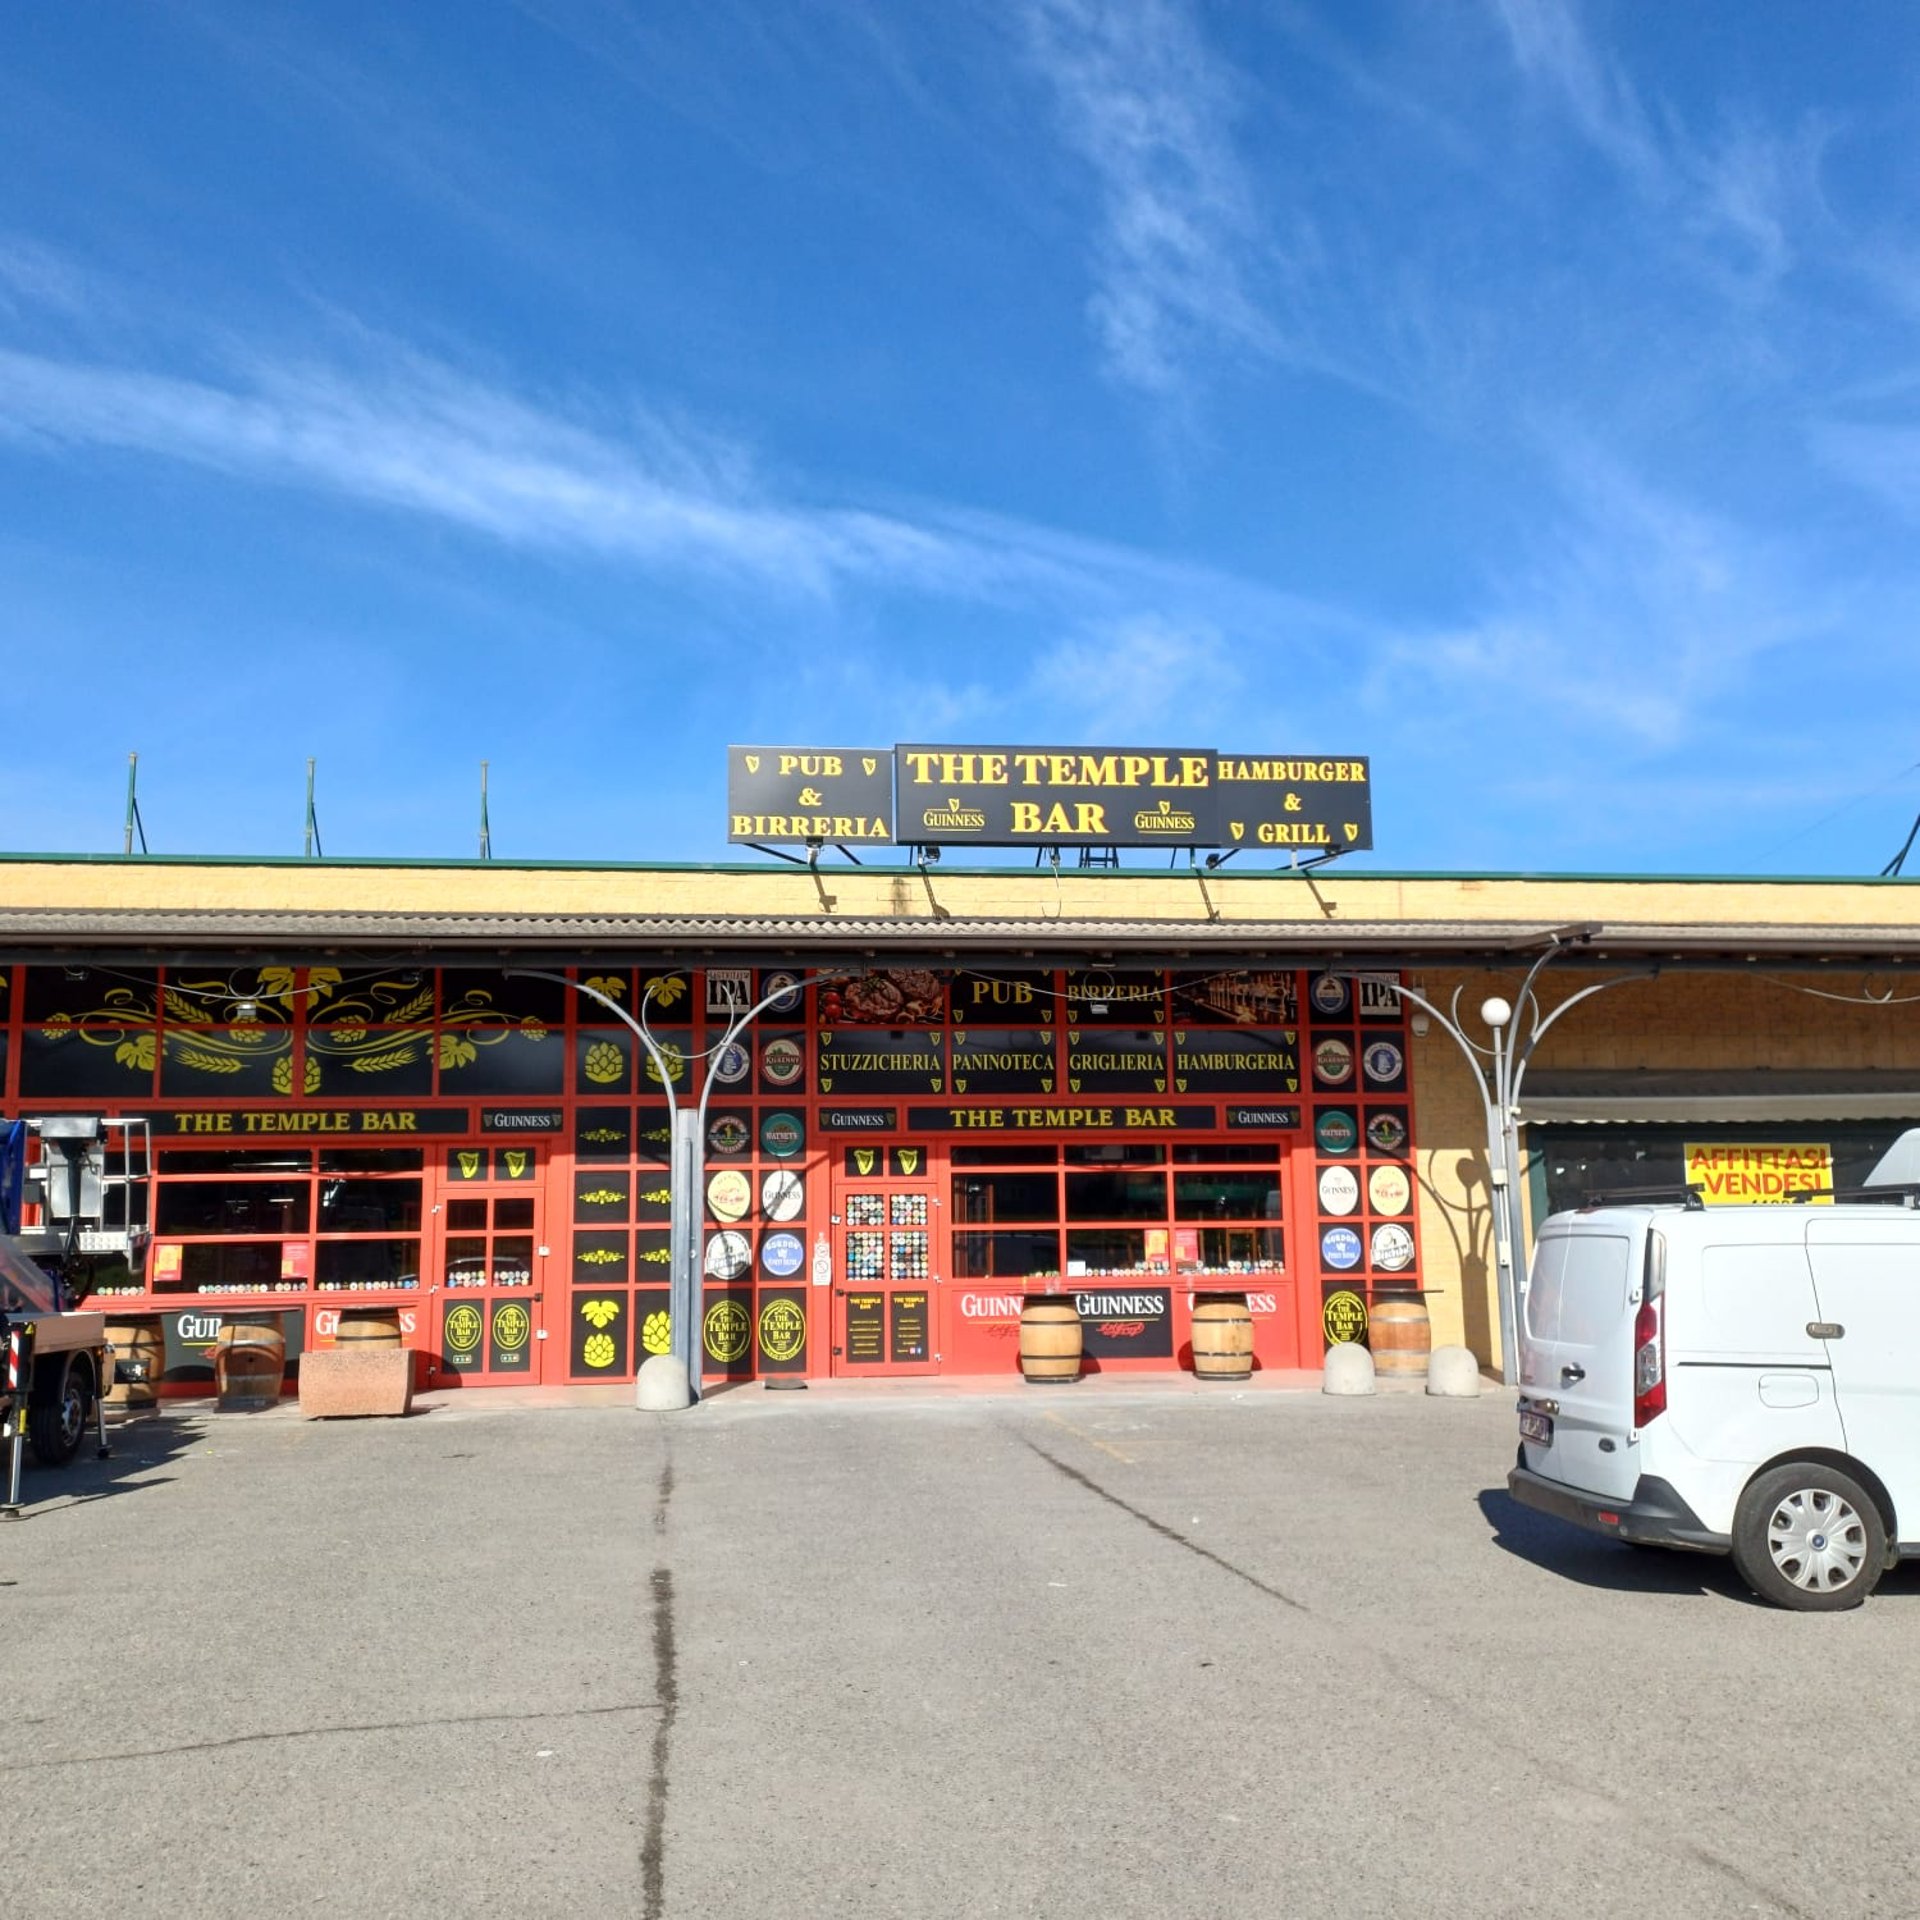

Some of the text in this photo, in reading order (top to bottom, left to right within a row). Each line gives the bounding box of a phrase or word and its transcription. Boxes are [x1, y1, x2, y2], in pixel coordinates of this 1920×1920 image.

[779, 756, 843, 776] PUB
[906, 753, 1209, 787] THE TEMPLE
[1217, 761, 1366, 782] HAMBURGER
[798, 788, 822, 806] &
[1284, 793, 1302, 811] &
[731, 816, 890, 837] BIRRERIA
[923, 811, 985, 828] GUINNESS
[1010, 802, 1109, 833] BAR
[1134, 813, 1195, 830] GUINNESS
[1258, 823, 1331, 843] GRILL
[709, 980, 750, 1005] IPA
[972, 981, 1033, 1004] PUB
[1361, 982, 1399, 1007] IPA
[820, 1054, 941, 1071] STUZZICHERIA
[952, 1054, 1055, 1071] PANINOTECA
[1069, 1054, 1165, 1071] GRIGLIERIA
[1177, 1054, 1295, 1071] HAMBURGERIA
[175, 1112, 417, 1132] THE TEMPLE BAR
[493, 1113, 551, 1128] GUINNESS
[831, 1113, 884, 1126] GUINNESS
[950, 1108, 1177, 1127] THE TEMPLE BAR
[1238, 1111, 1289, 1124] GUINNESS
[1691, 1148, 1827, 1170] AFFITTASI
[1704, 1173, 1822, 1195] VENDESI
[961, 1294, 1024, 1317] GUINN
[1076, 1295, 1164, 1315] GUINNESS
[1326, 1310, 1363, 1322] TEMPLE
[708, 1320, 747, 1331] TEMPLE
[763, 1320, 802, 1331] TEMPLE
[1336, 1321, 1354, 1330] BAR
[773, 1331, 791, 1340] BAR
